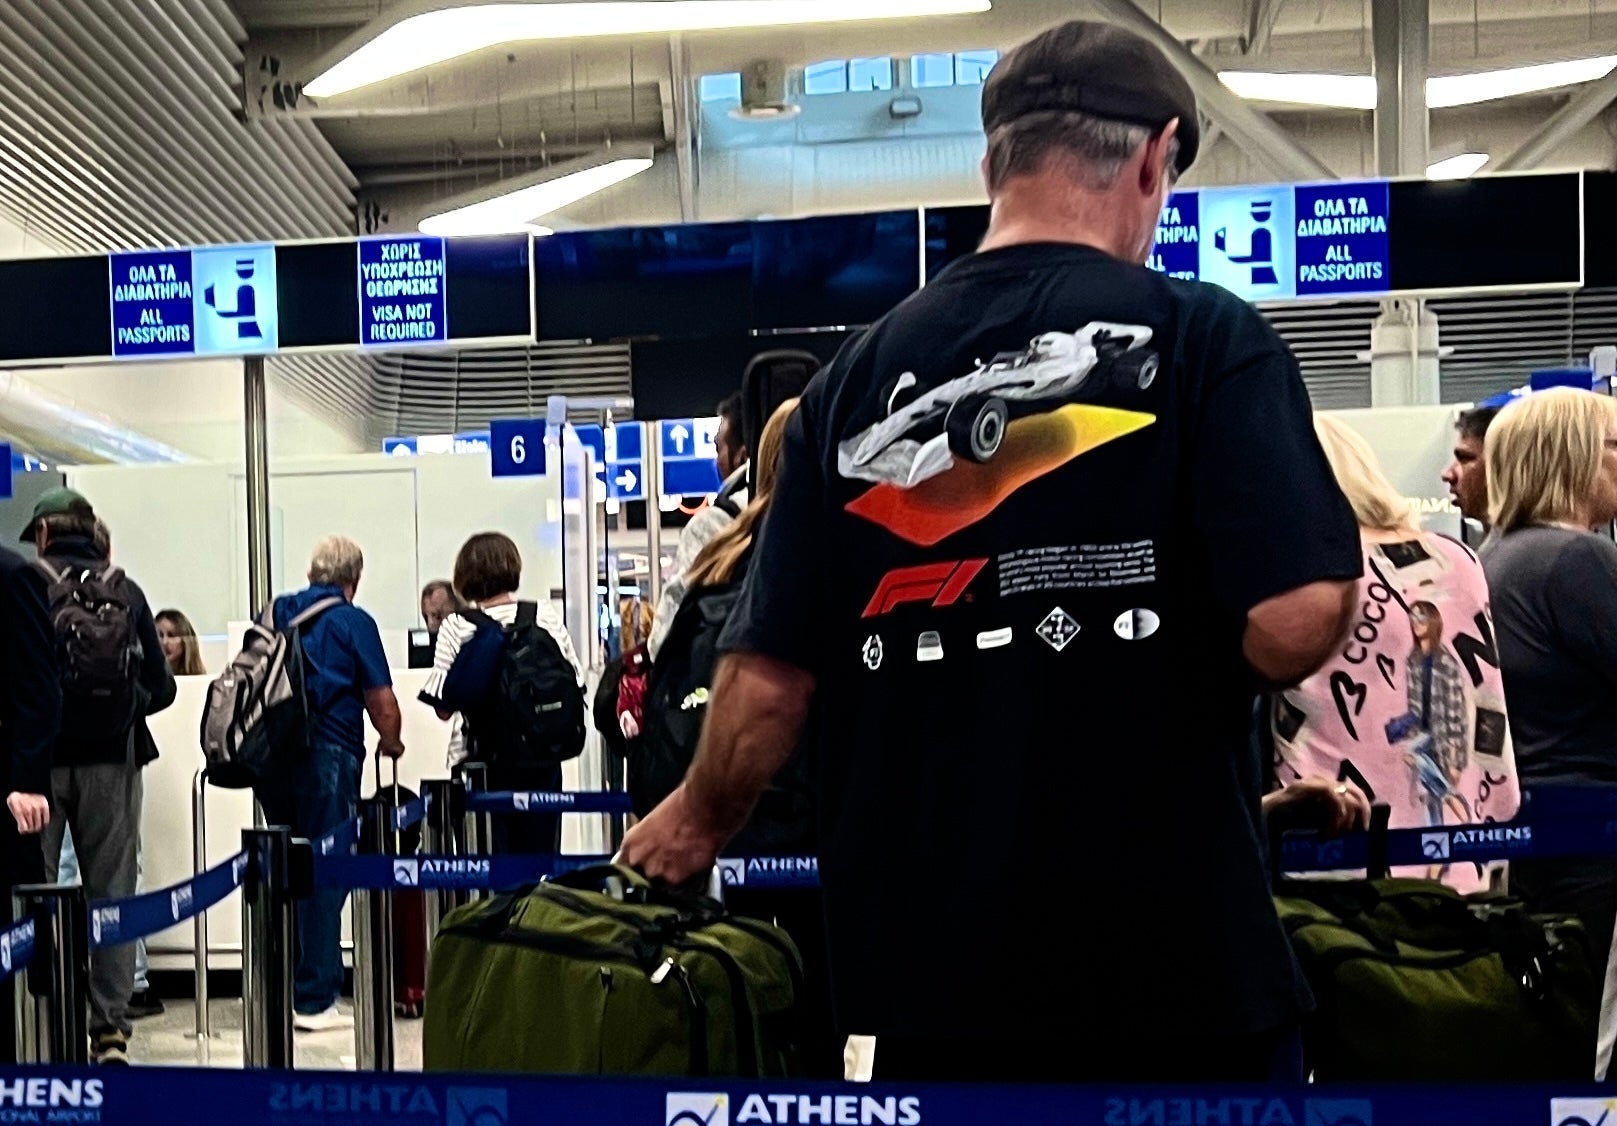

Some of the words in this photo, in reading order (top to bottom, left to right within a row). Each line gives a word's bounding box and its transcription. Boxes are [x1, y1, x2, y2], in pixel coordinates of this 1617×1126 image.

[1314, 198, 1346, 217] ΟΛΑ
[1348, 197, 1368, 215] ΤΑ
[1297, 215, 1387, 237] ΔΙΑΒΑΤΗΡΙΑ
[381, 242, 421, 261] ΧΩΡΙΣ
[1325, 244, 1352, 262] ALL
[129, 265, 157, 283] ΟΛΑ
[158, 263, 176, 282] ΤΑ
[1300, 261, 1383, 282] PASSPORTS
[114, 281, 192, 302] ΔΙΑΒΑΤΗΡΙΑ
[140, 308, 164, 326] ALL
[372, 304, 403, 322] VISA
[405, 302, 433, 320] NOT
[118, 324, 190, 345] PASSPORTS
[370, 320, 436, 340] REQUIRED
[510, 435, 526, 464] 6
[1343, 581, 1393, 664] COCO
[1452, 826, 1532, 844] ATHENS
[422, 859, 490, 875] ATHENS
[736, 1093, 921, 1126] ATHENS
